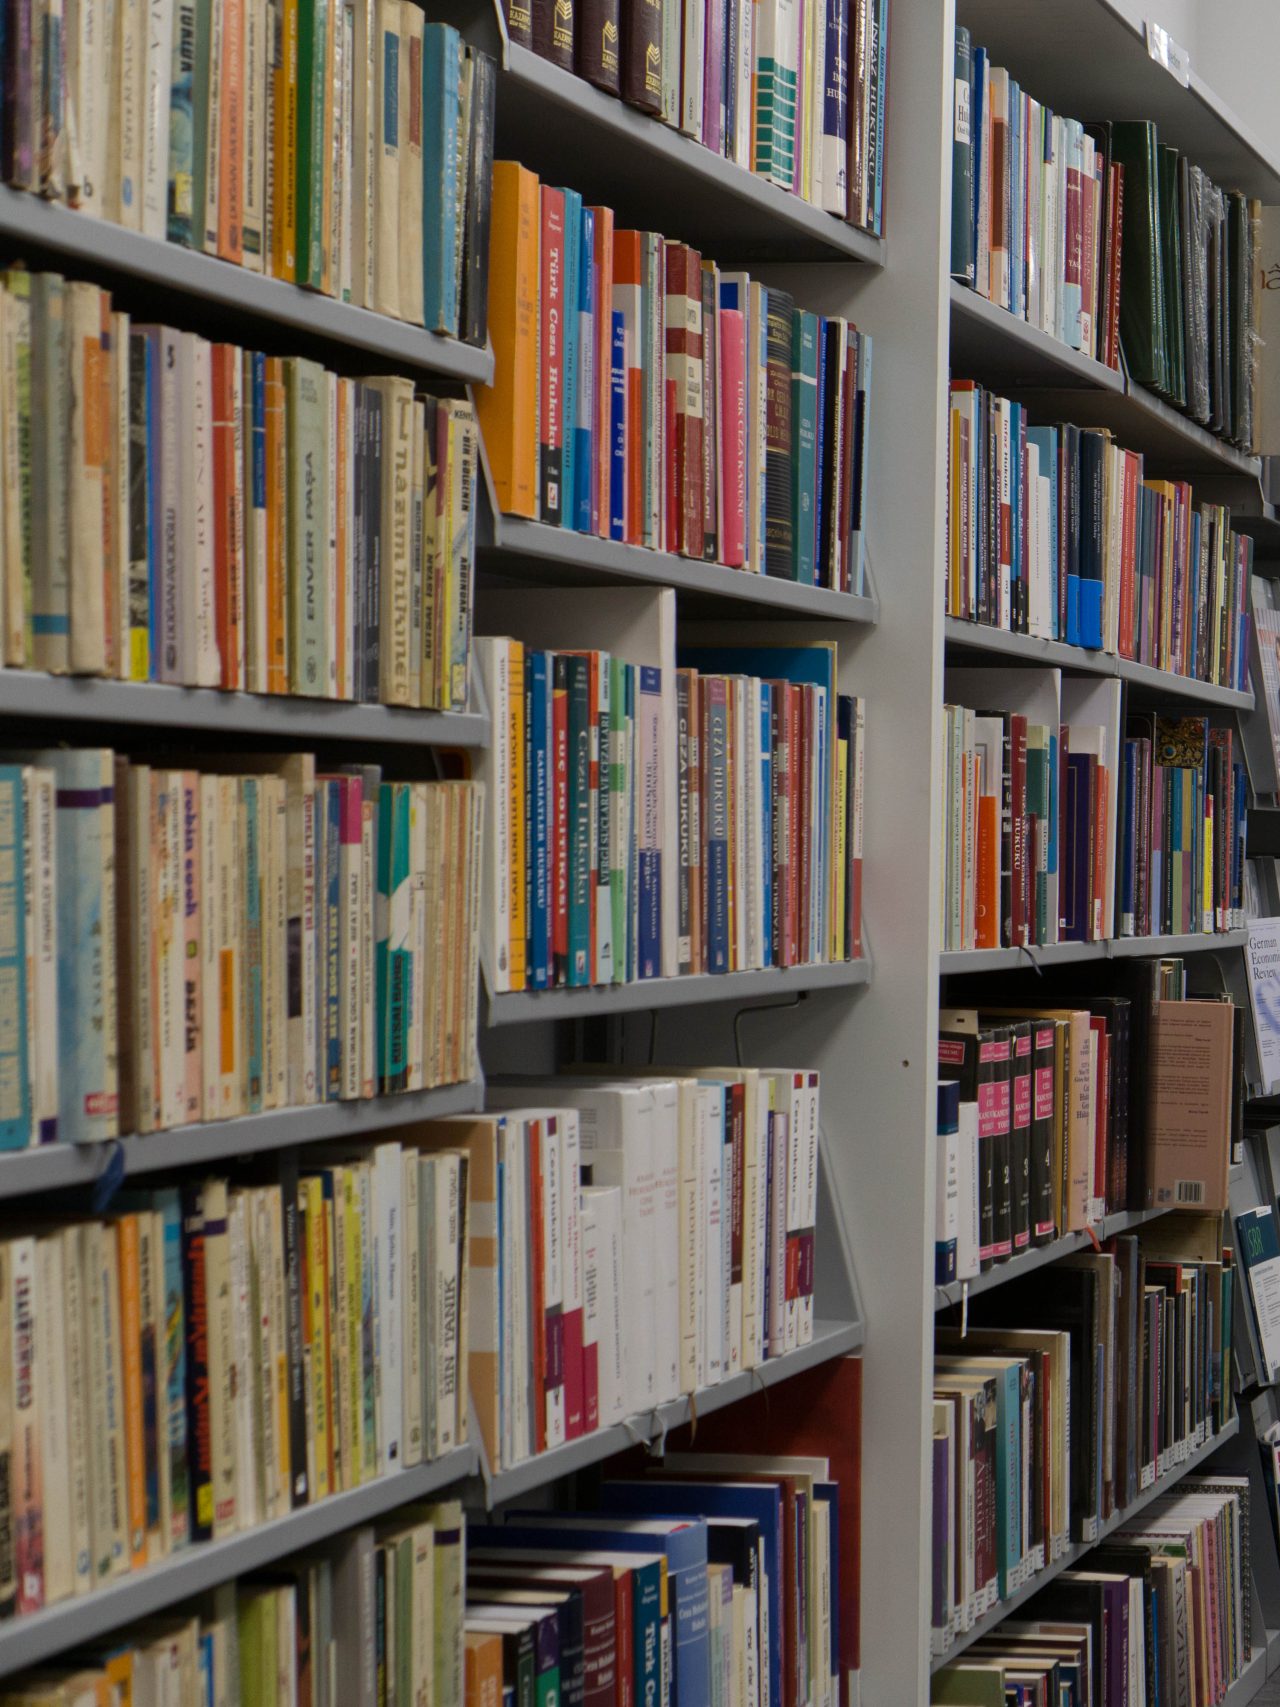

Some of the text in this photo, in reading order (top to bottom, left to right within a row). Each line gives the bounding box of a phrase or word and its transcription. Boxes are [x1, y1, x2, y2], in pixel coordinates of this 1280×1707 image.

[868, 20, 880, 174] İNFAZ HUKUKU
[548, 247, 559, 450] Türk Ceza Hukuku
[736, 379, 744, 518] TÜRK CEZA KANUNU
[304, 451, 316, 620] ENVER PAŞA
[511, 773, 518, 791] VE
[714, 717, 723, 757] CEZA
[511, 796, 519, 864] SENETLER
[537, 750, 546, 909] KABAHATLER HUKUKU
[558, 730, 568, 916] SUÇ POLİTİKASI
[578, 731, 589, 905] Ceza Hukuku
[600, 715, 610, 882] VERGİ SUÇLARI VE CEZALARI
[680, 718, 688, 867] CEZA HUKUKU
[714, 767, 723, 836] HUKUKU
[511, 870, 519, 919] TİCARİ
[329, 905, 338, 1039] HEY KOCA YURT
[1250, 937, 1277, 951] German
[1252, 966, 1278, 980] Review
[791, 1100, 800, 1193] Ceza Hukuku
[807, 1097, 816, 1189] Ceza Hukuku
[986, 1168, 992, 1188] 1
[1004, 1165, 1010, 1184] 2
[1024, 1158, 1030, 1177] 3
[1044, 1148, 1052, 1167] 4
[572, 1162, 580, 1299] Türk Ceza Hukukuna
[688, 1191, 696, 1326] MEDENİ HUKUK
[748, 1246, 756, 1304] HUKUK
[1248, 1227, 1264, 1257] SBR
[444, 1277, 456, 1395] BİN TANIK
[976, 1459, 986, 1550] Atatürk
[644, 1621, 656, 1674] Türk
